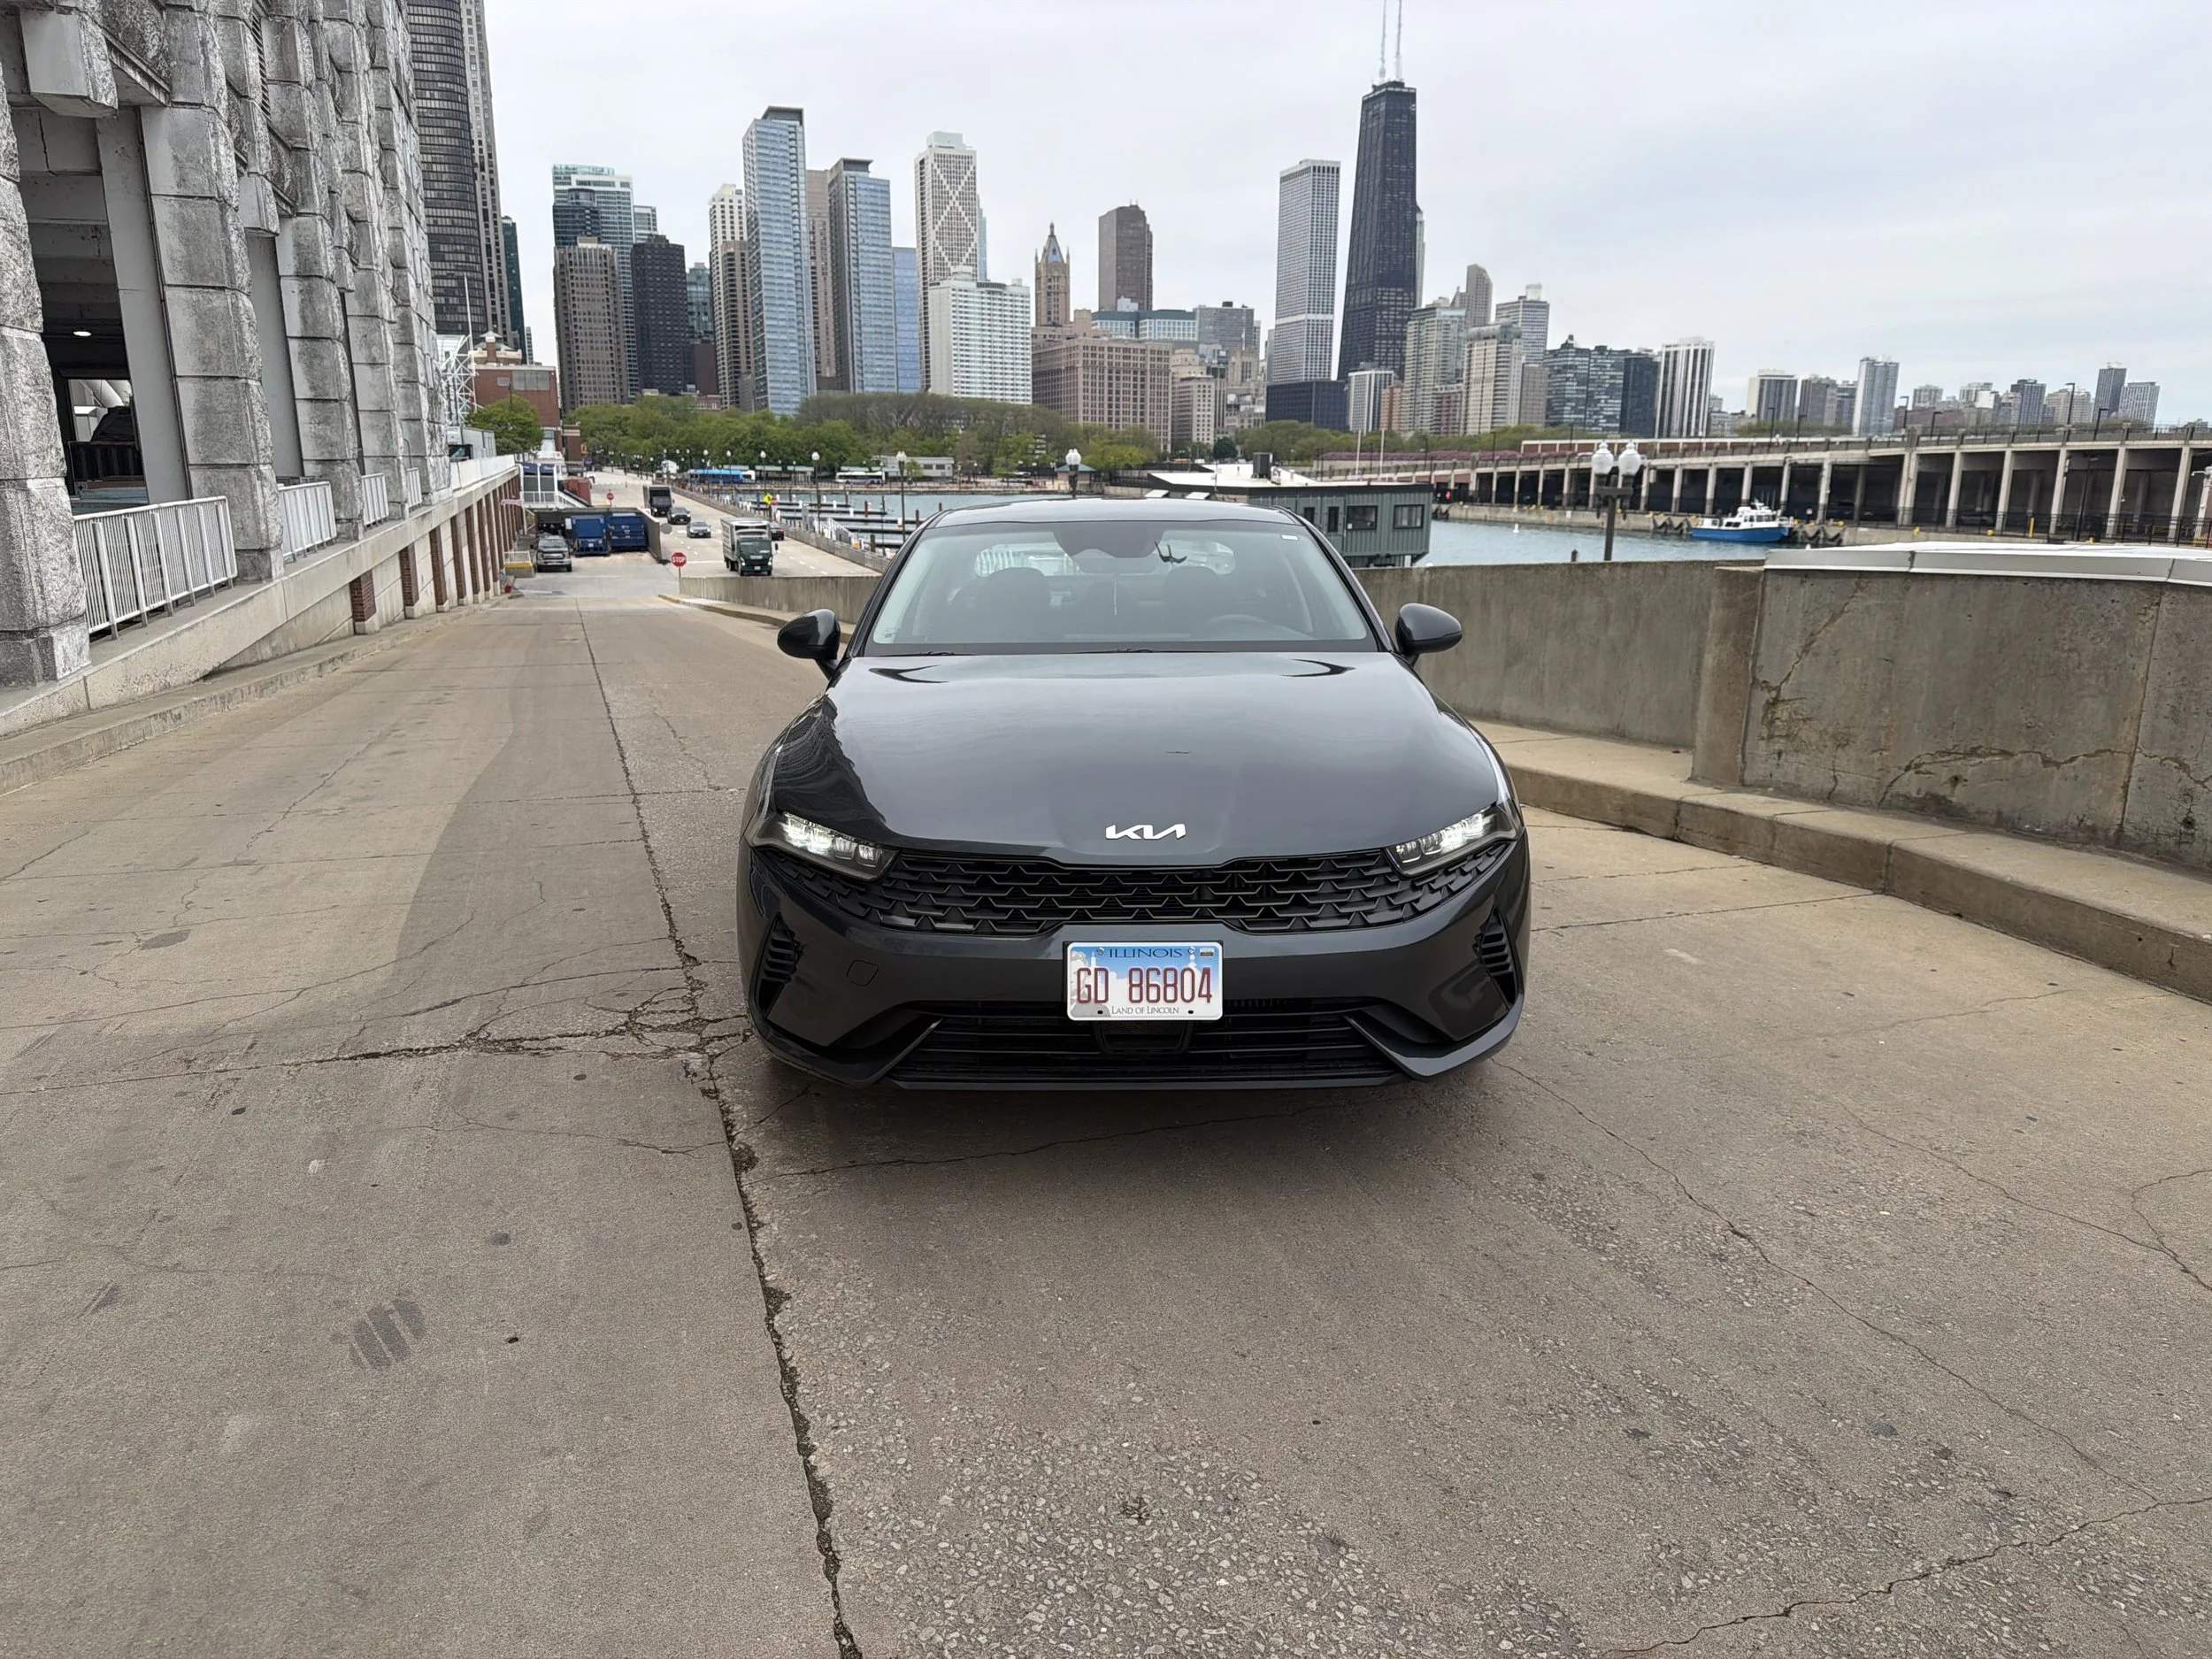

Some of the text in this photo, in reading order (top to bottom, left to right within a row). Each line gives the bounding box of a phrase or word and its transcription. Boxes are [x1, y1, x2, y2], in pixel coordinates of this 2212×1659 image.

[1106, 824, 1187, 840] KIA
[1109, 948, 1182, 958] ILLINOIS
[1077, 967, 1213, 1004] GD 86804
